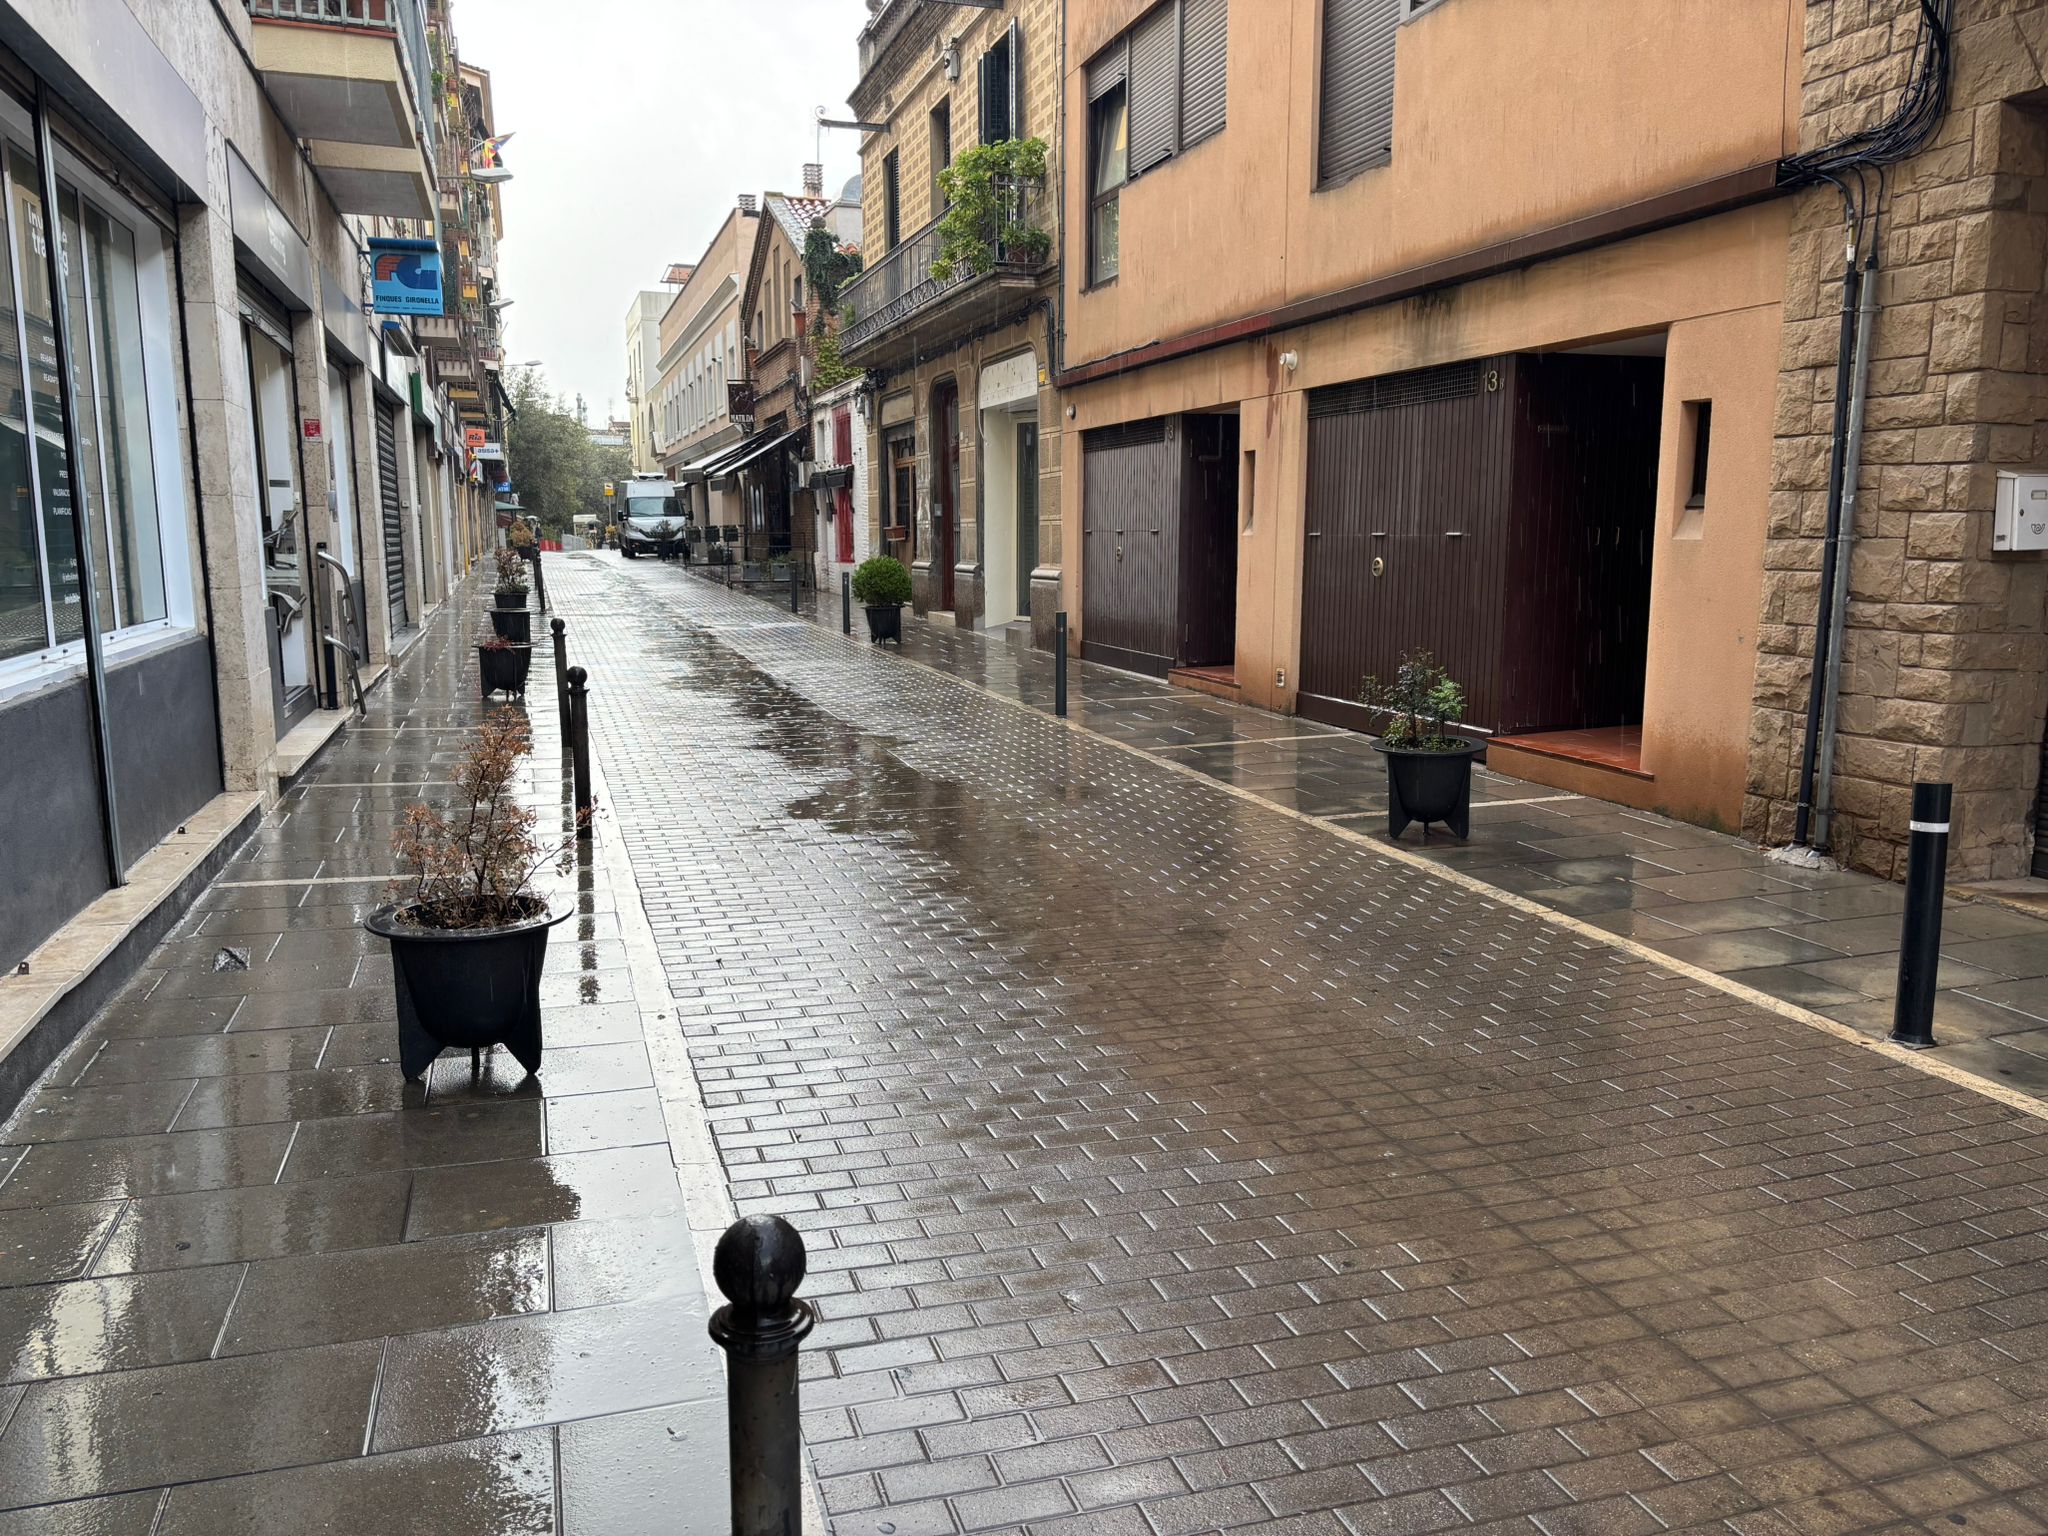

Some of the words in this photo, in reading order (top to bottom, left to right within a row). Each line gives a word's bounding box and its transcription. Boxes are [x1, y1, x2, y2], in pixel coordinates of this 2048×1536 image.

[376, 295, 402, 303] FINQUES
[405, 296, 440, 305] GIRONELLA
[1482, 370, 1498, 393] 13
[730, 414, 754, 423] MATILDA
